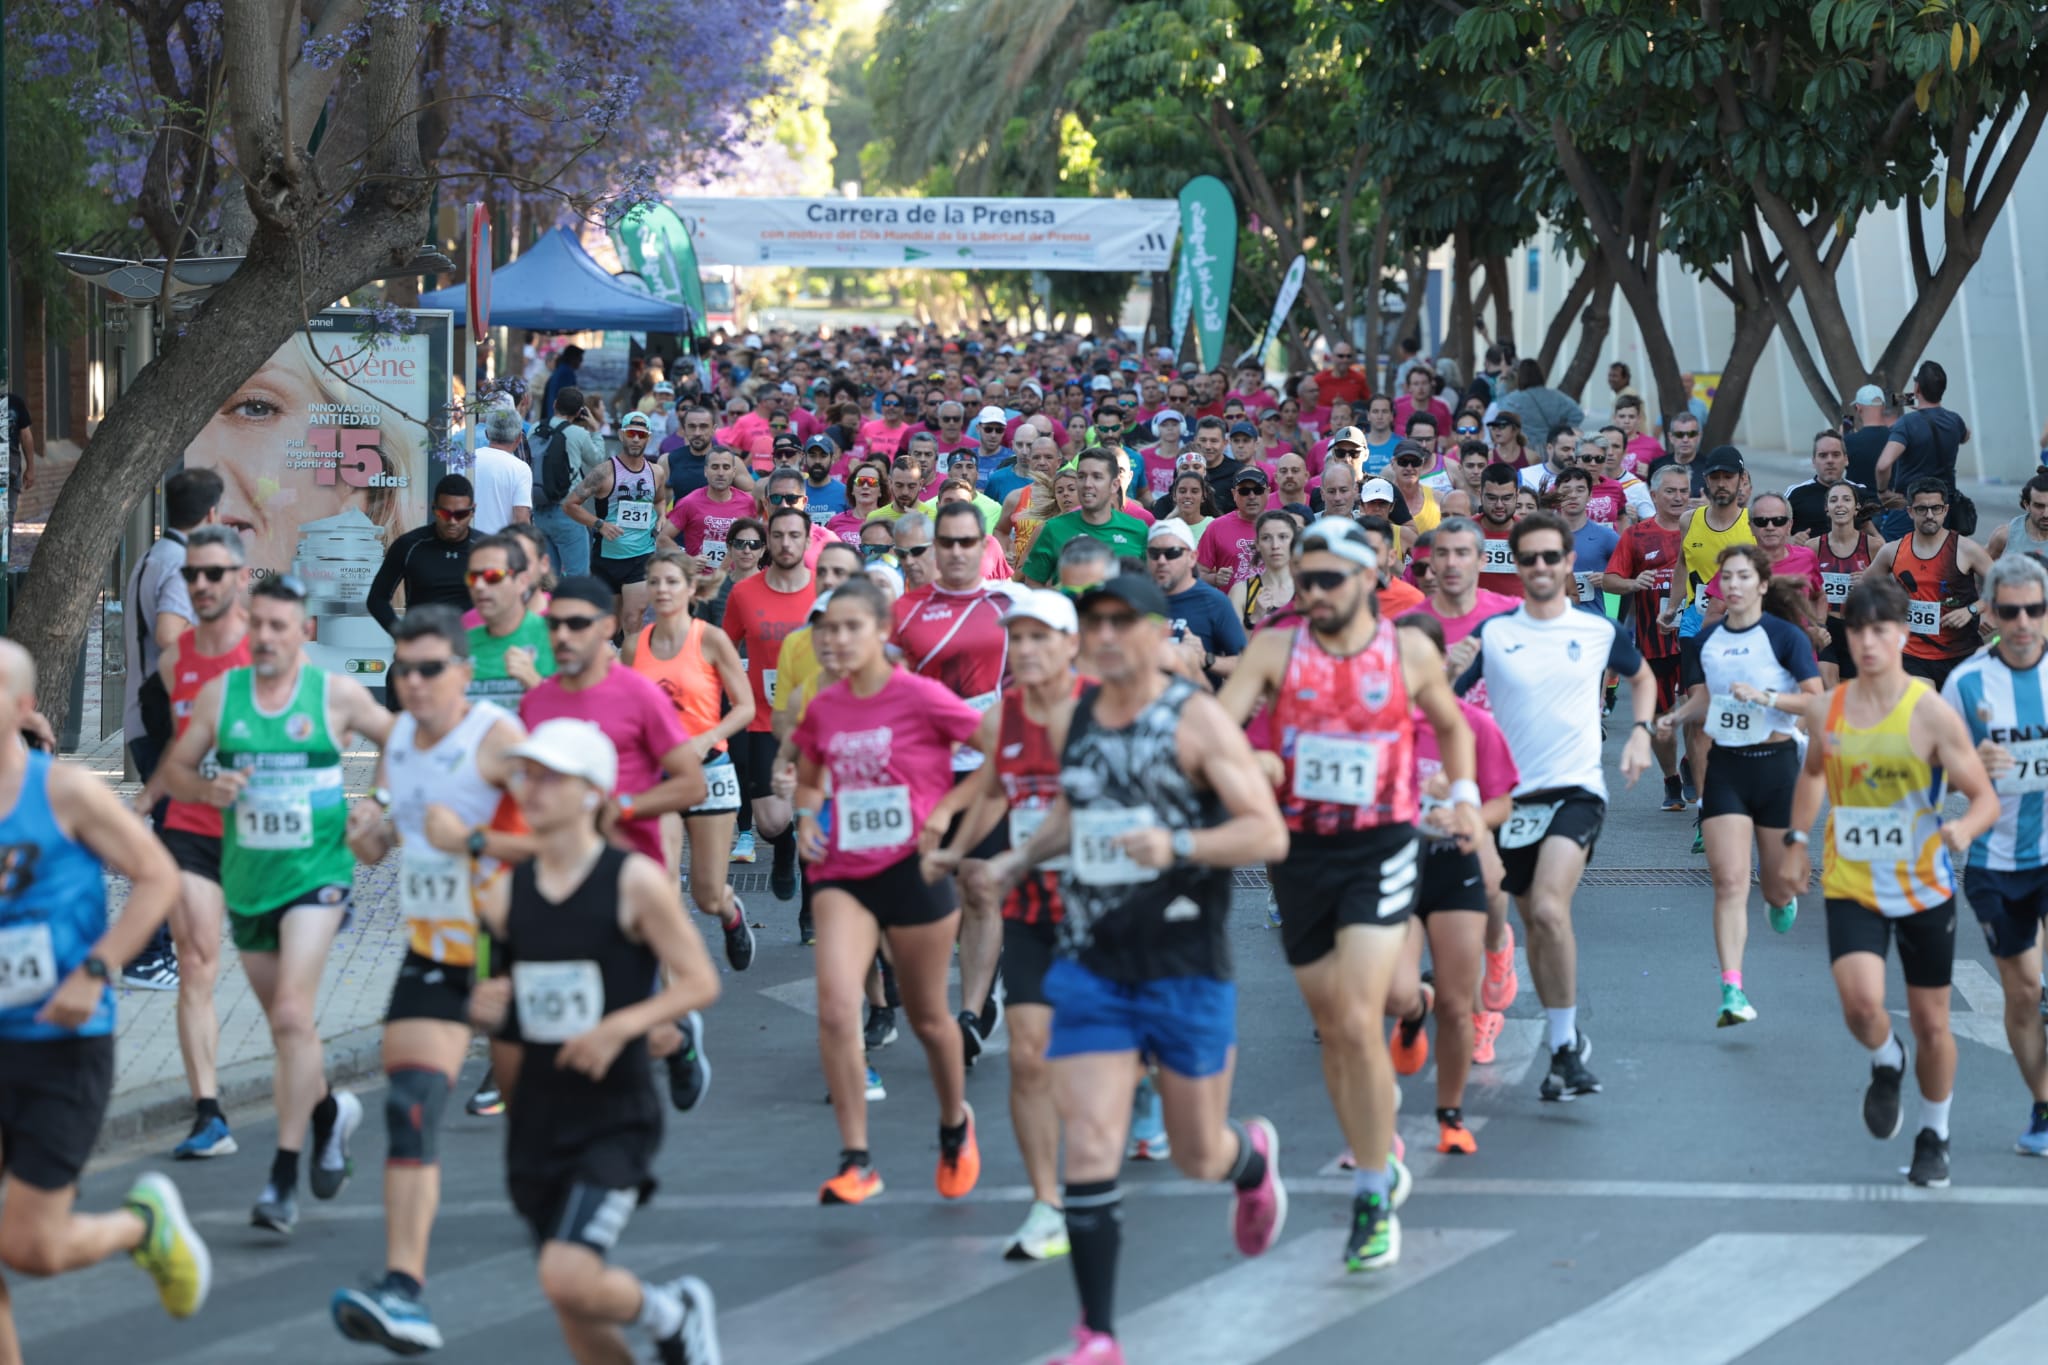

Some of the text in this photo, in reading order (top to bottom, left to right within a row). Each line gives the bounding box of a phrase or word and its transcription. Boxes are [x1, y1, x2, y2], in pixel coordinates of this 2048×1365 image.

[807, 204, 1055, 225] Carrera de la Prensa
[760, 229, 785, 239] con
[788, 228, 834, 240] motivo
[836, 228, 857, 240] del
[884, 229, 934, 241] Mundial
[937, 230, 953, 241] de
[956, 230, 969, 241] la
[971, 230, 1026, 242] Libertad
[1030, 231, 1046, 242] de
[1048, 231, 1092, 242] Prensa
[309, 317, 334, 327] annel
[307, 402, 380, 413] INNOVACIÓN
[308, 413, 380, 426] ANTIEDAD
[286, 439, 304, 448] Piel
[286, 450, 344, 460] regenerada
[307, 428, 383, 488] 15
[294, 460, 322, 470] partir
[324, 460, 337, 469] de
[367, 471, 408, 488] días
[621, 510, 648, 522] 231
[1722, 647, 1750, 657] FILA
[1720, 712, 1750, 731] 98
[1305, 760, 1364, 785] 311
[706, 779, 736, 798] 05
[246, 811, 302, 833] 185
[847, 807, 903, 832] 680
[1510, 818, 1540, 835] 27
[1844, 827, 1904, 846] 414
